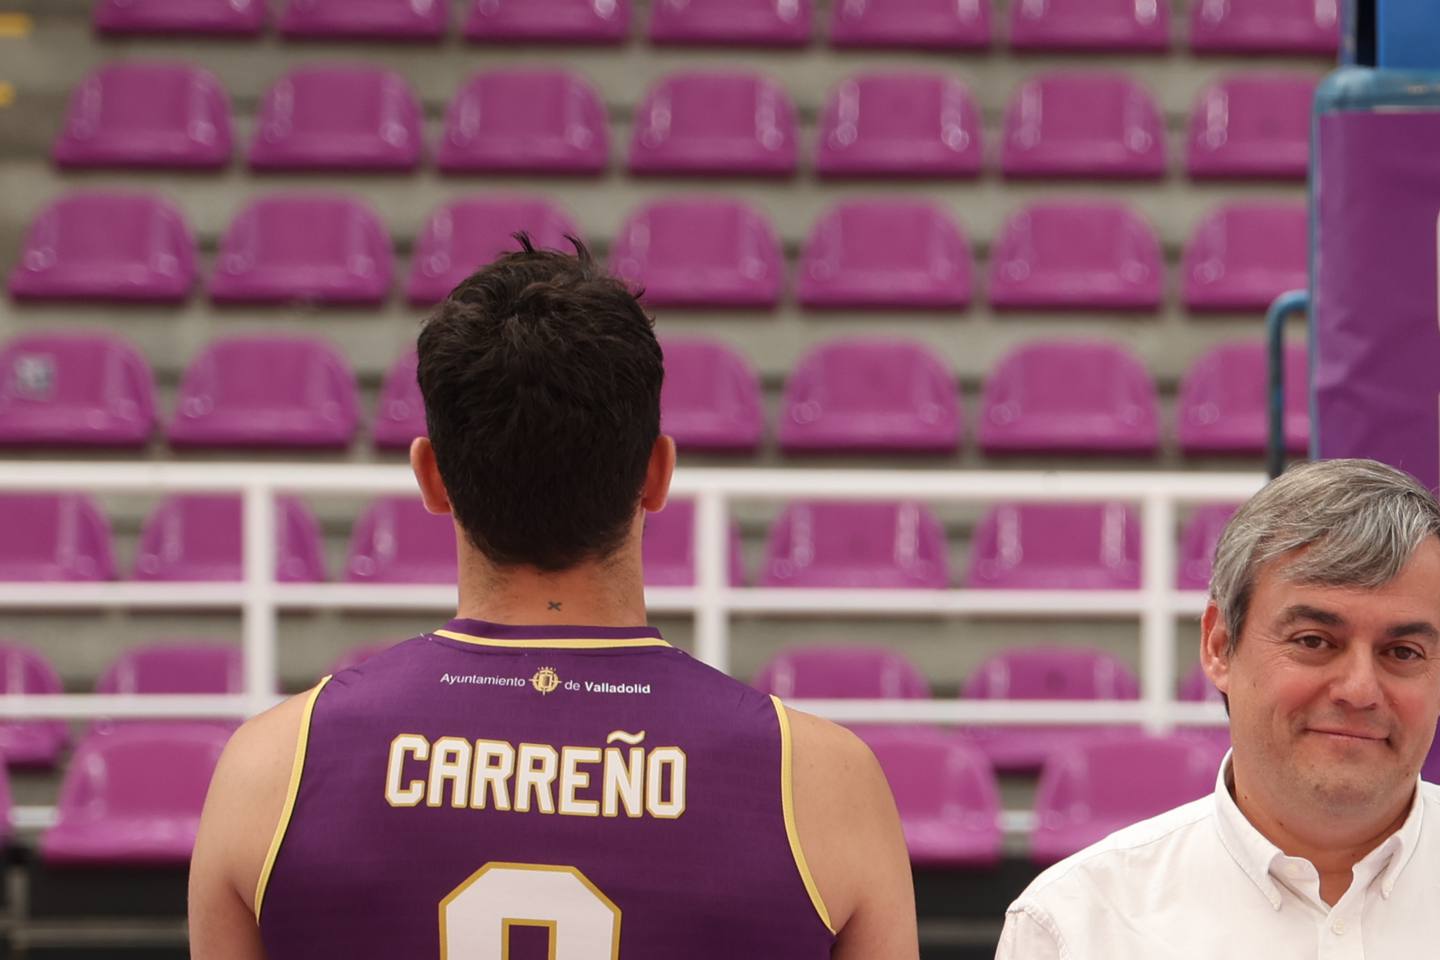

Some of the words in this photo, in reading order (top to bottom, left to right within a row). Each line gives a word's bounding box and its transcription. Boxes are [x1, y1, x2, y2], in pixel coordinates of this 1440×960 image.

[440, 673, 526, 687] Ayuntamiento
[564, 679, 581, 691] de
[585, 681, 651, 694] Valladolid
[384, 730, 687, 819] CARREÑO
